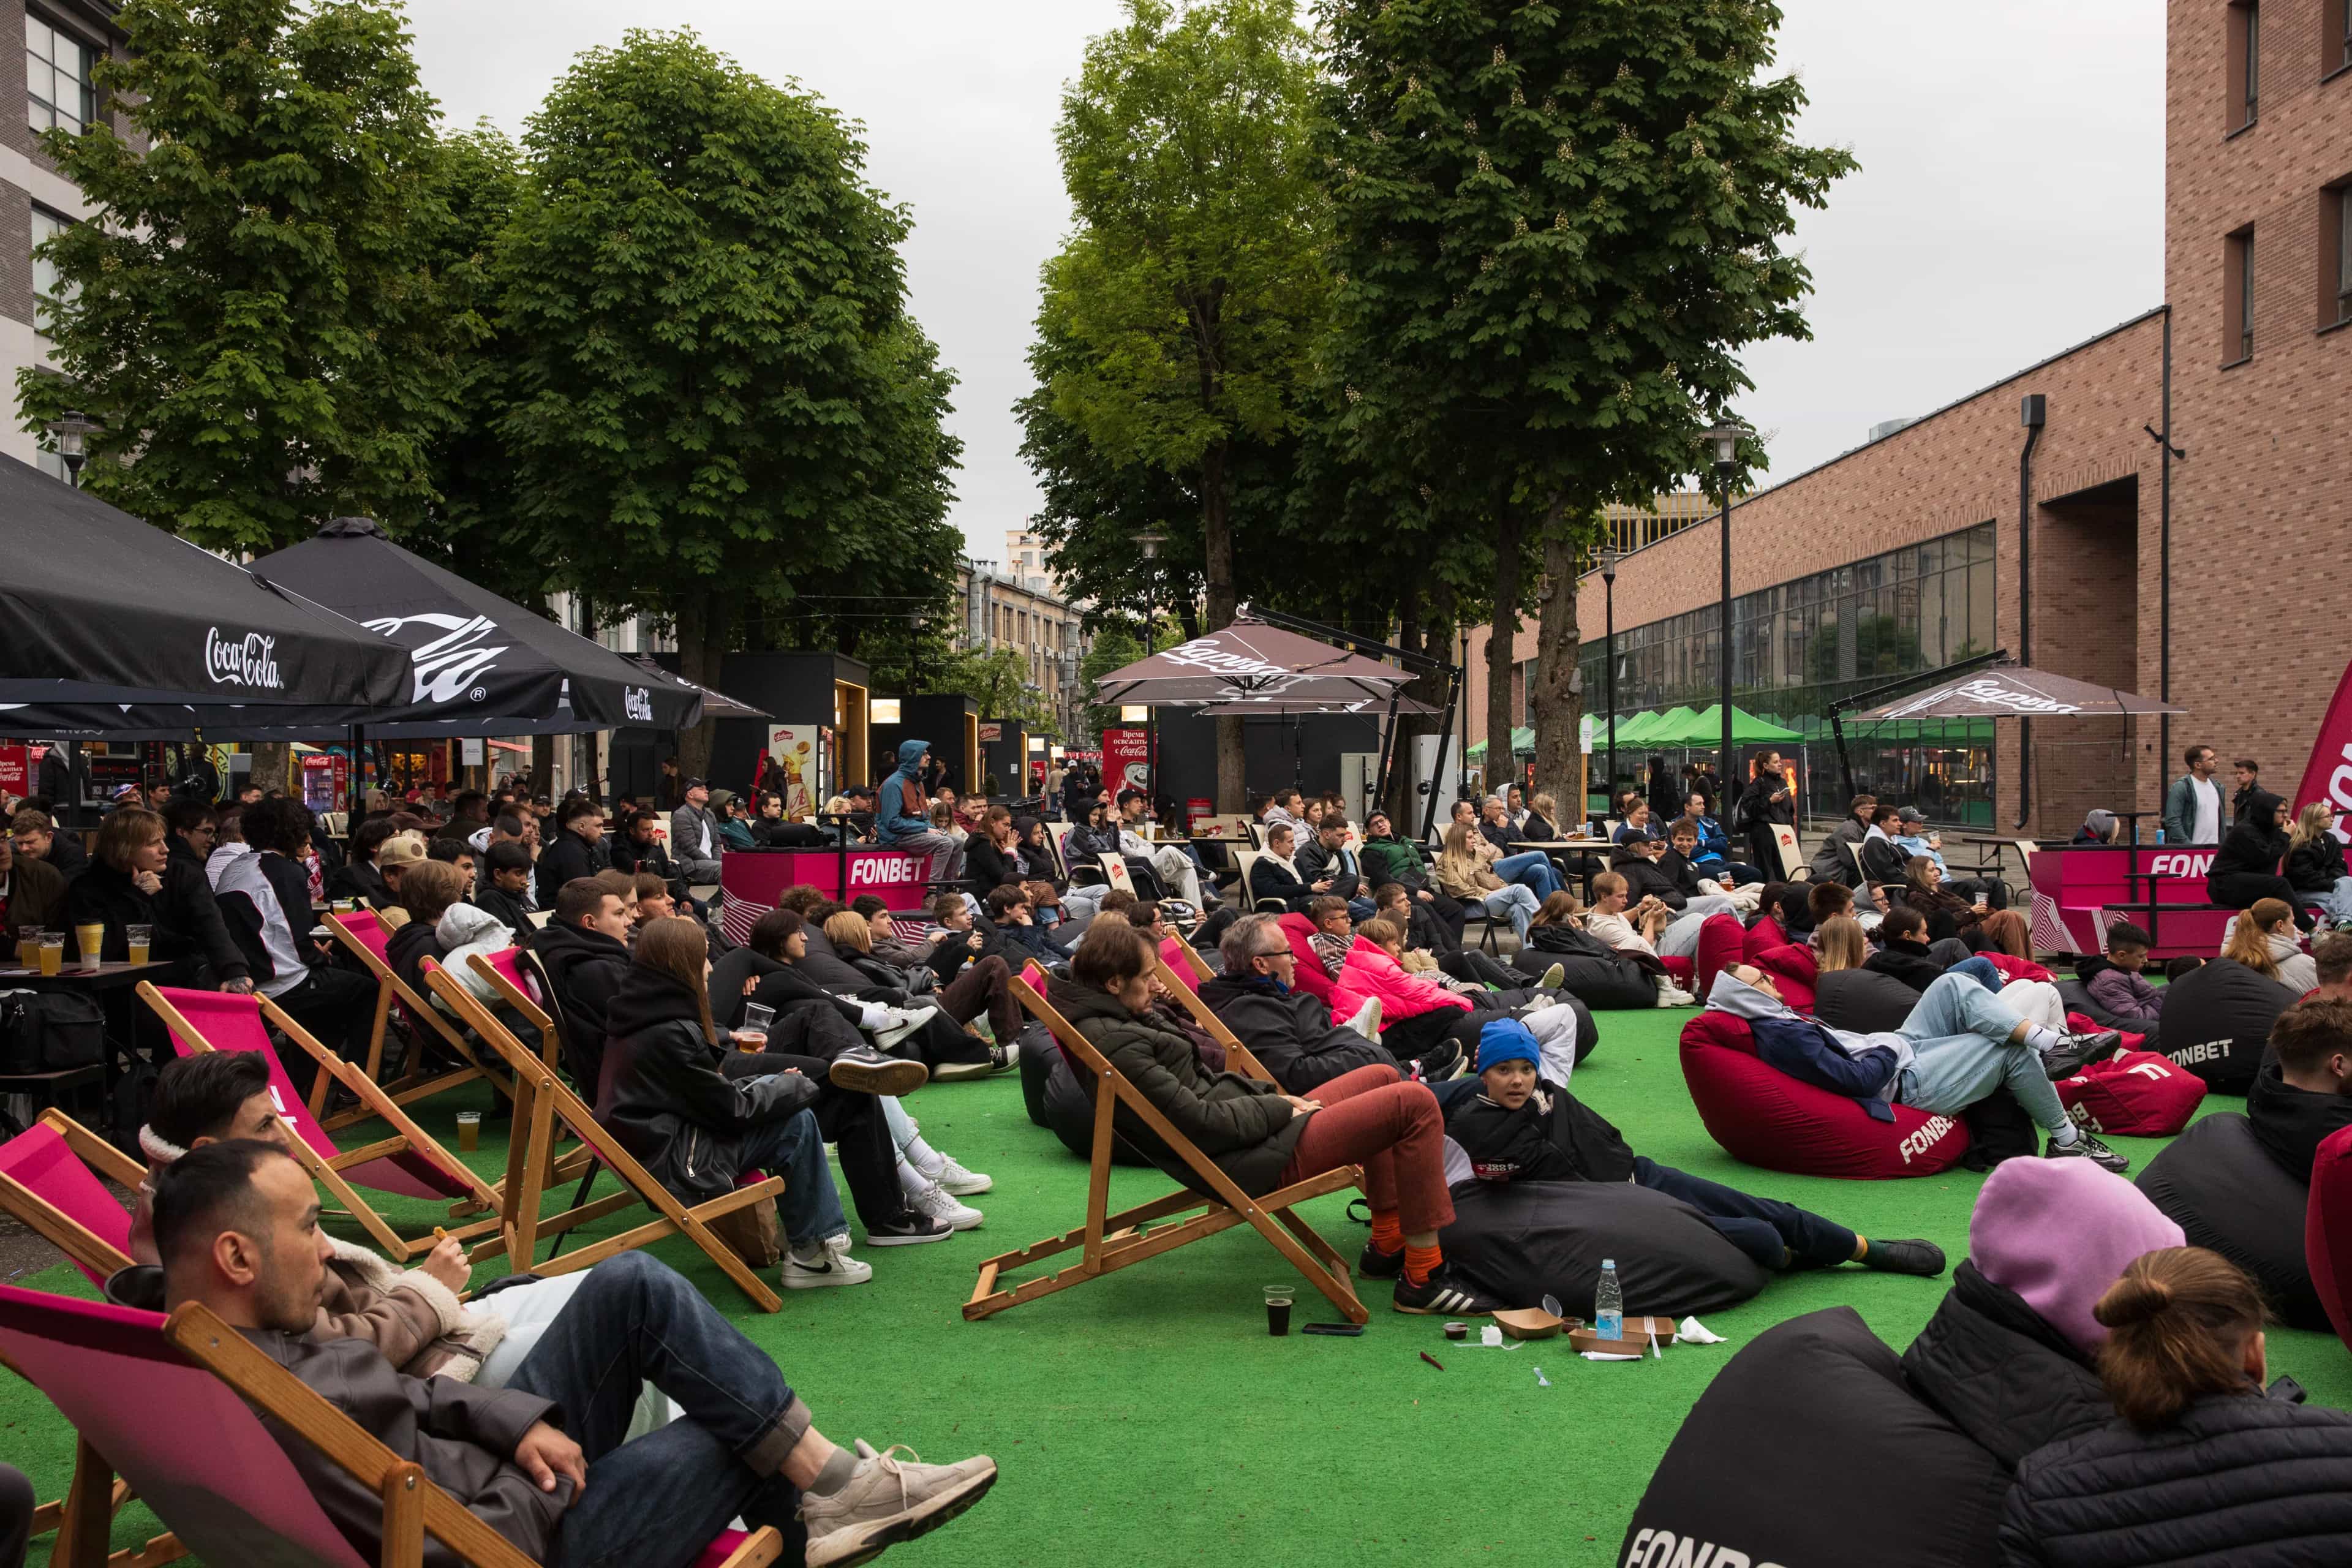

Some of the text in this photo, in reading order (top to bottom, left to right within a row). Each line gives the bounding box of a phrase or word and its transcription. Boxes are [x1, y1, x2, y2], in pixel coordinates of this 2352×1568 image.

[205, 626, 279, 688] Coca-Cola
[625, 685, 652, 721] Coca-Cola
[1123, 730, 1144, 739] Время
[305, 757, 329, 766] Coca-Cola
[851, 858, 925, 884] FONBET
[2151, 854, 2215, 878] FON
[1900, 1115, 1958, 1165] FONBE
